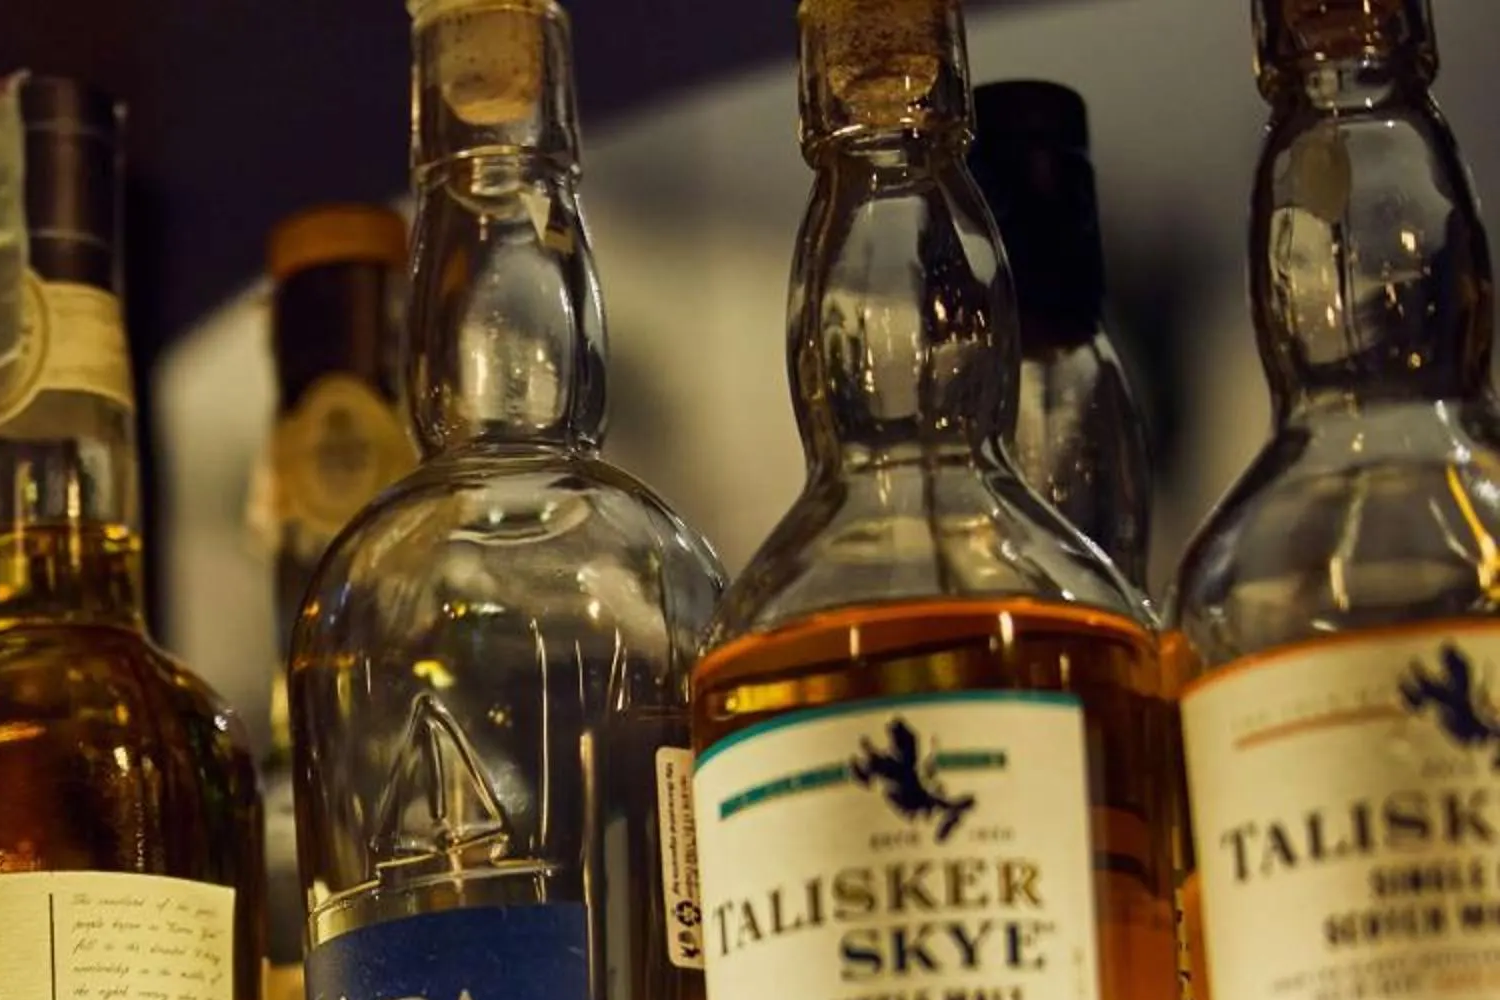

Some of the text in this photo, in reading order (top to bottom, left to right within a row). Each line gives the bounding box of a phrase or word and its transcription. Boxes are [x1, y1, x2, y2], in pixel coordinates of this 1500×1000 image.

[1220, 789, 1493, 883] TALISK
[712, 854, 1045, 958] TALISKER
[840, 919, 1047, 982] SKYE
